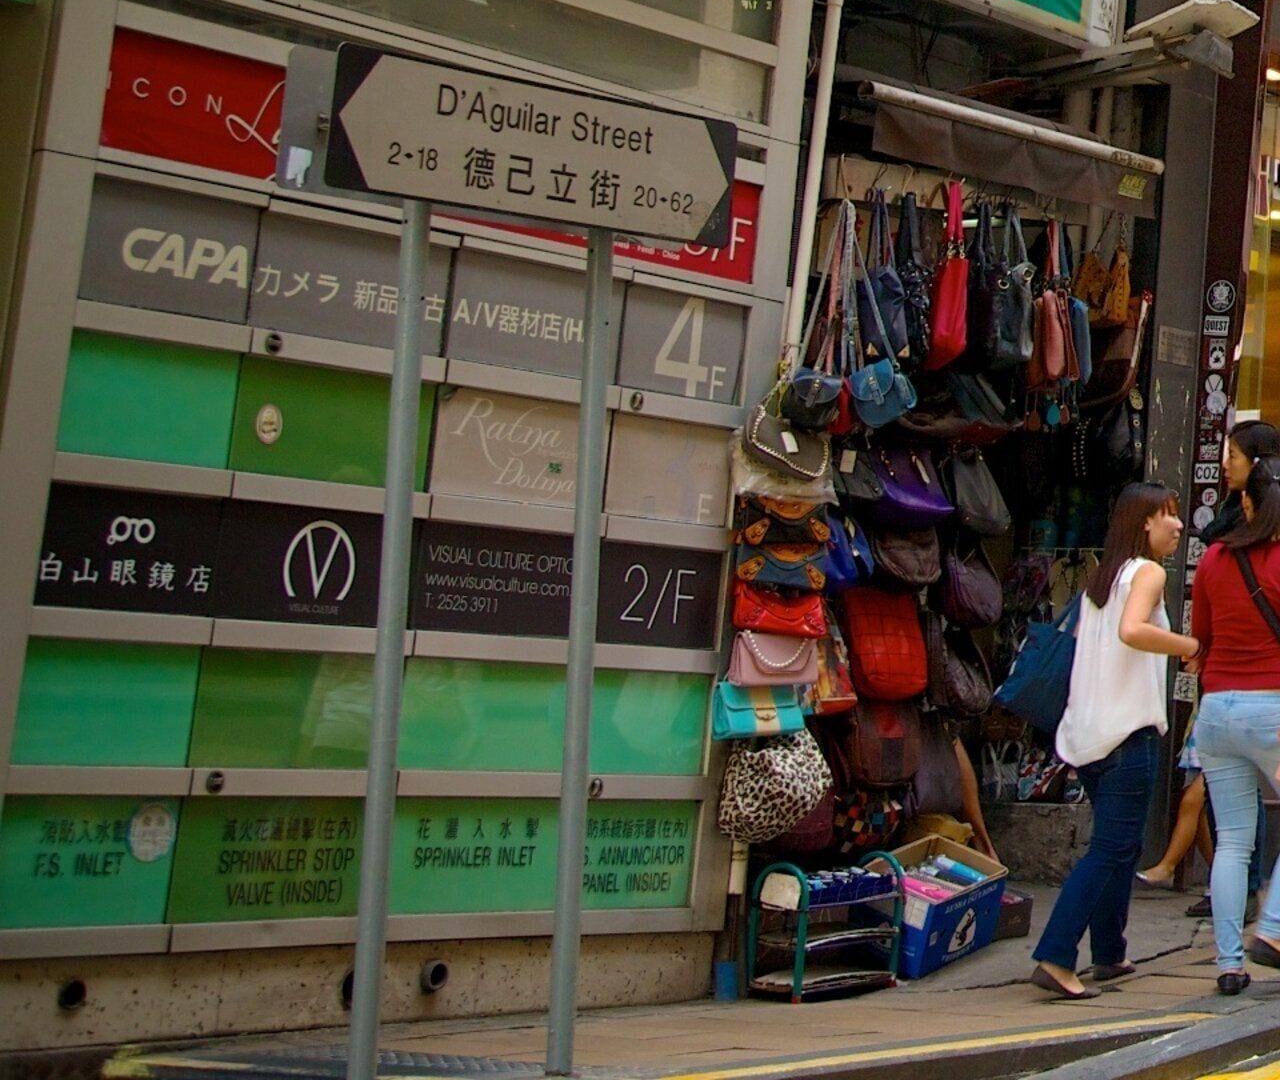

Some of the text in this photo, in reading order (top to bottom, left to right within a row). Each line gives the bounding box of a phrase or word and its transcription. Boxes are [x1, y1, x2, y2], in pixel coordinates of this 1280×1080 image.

[437, 84, 654, 154] D'Aguilar Street
[463, 145, 622, 212] 德己立街
[122, 228, 248, 289] CAPA
[255, 264, 341, 303] カメラ
[1195, 465, 1219, 482] COZ
[429, 544, 474, 566] VISUAL
[478, 548, 534, 572] CULTURE
[39, 552, 212, 593] 白山眼鏡店
[424, 592, 499, 614] T: 2525 3911
[619, 563, 698, 630] 2/F
[74, 850, 127, 876] INLET
[218, 847, 356, 875] SPRINKLER STOP
[413, 845, 537, 870] SPRINKLER INLET
[598, 844, 687, 866] ANNUNCIATOR
[225, 878, 344, 907] VALVE (INSIDE)
[582, 871, 672, 895] PANEL (INSIDE)
